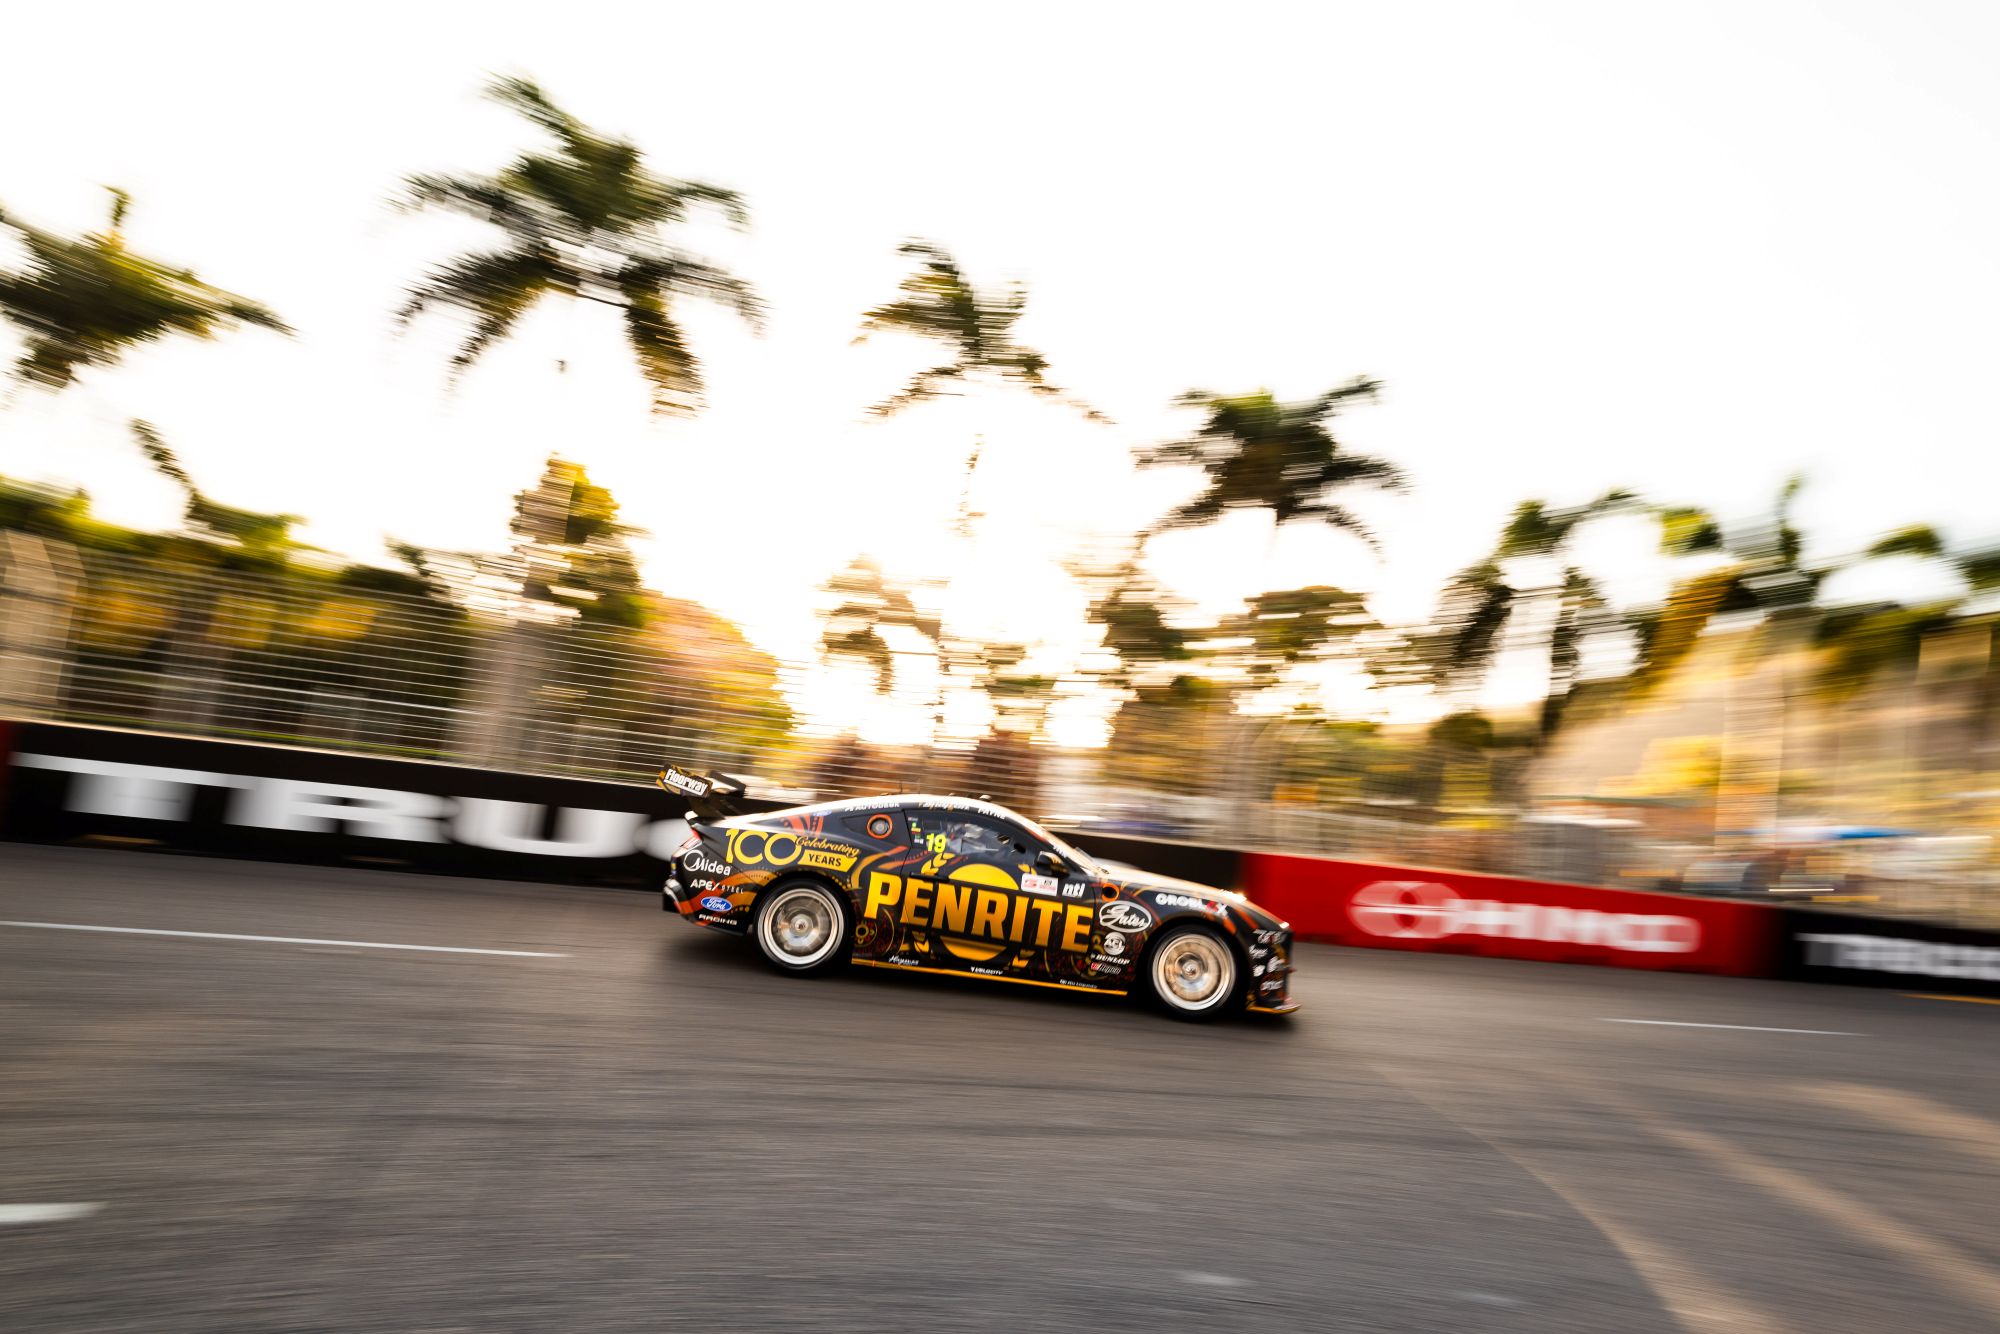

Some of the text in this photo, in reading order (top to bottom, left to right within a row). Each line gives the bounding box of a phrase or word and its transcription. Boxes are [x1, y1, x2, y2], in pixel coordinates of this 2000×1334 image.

[665, 768, 709, 794] Floorway
[796, 836, 860, 858] Celebrating
[926, 833, 947, 853] 19
[684, 849, 731, 876] Midea
[808, 853, 842, 867] YEARS
[863, 871, 1095, 953] PENRITE
[1101, 904, 1148, 928] Gates
[1096, 954, 1131, 965] DUNLOP
